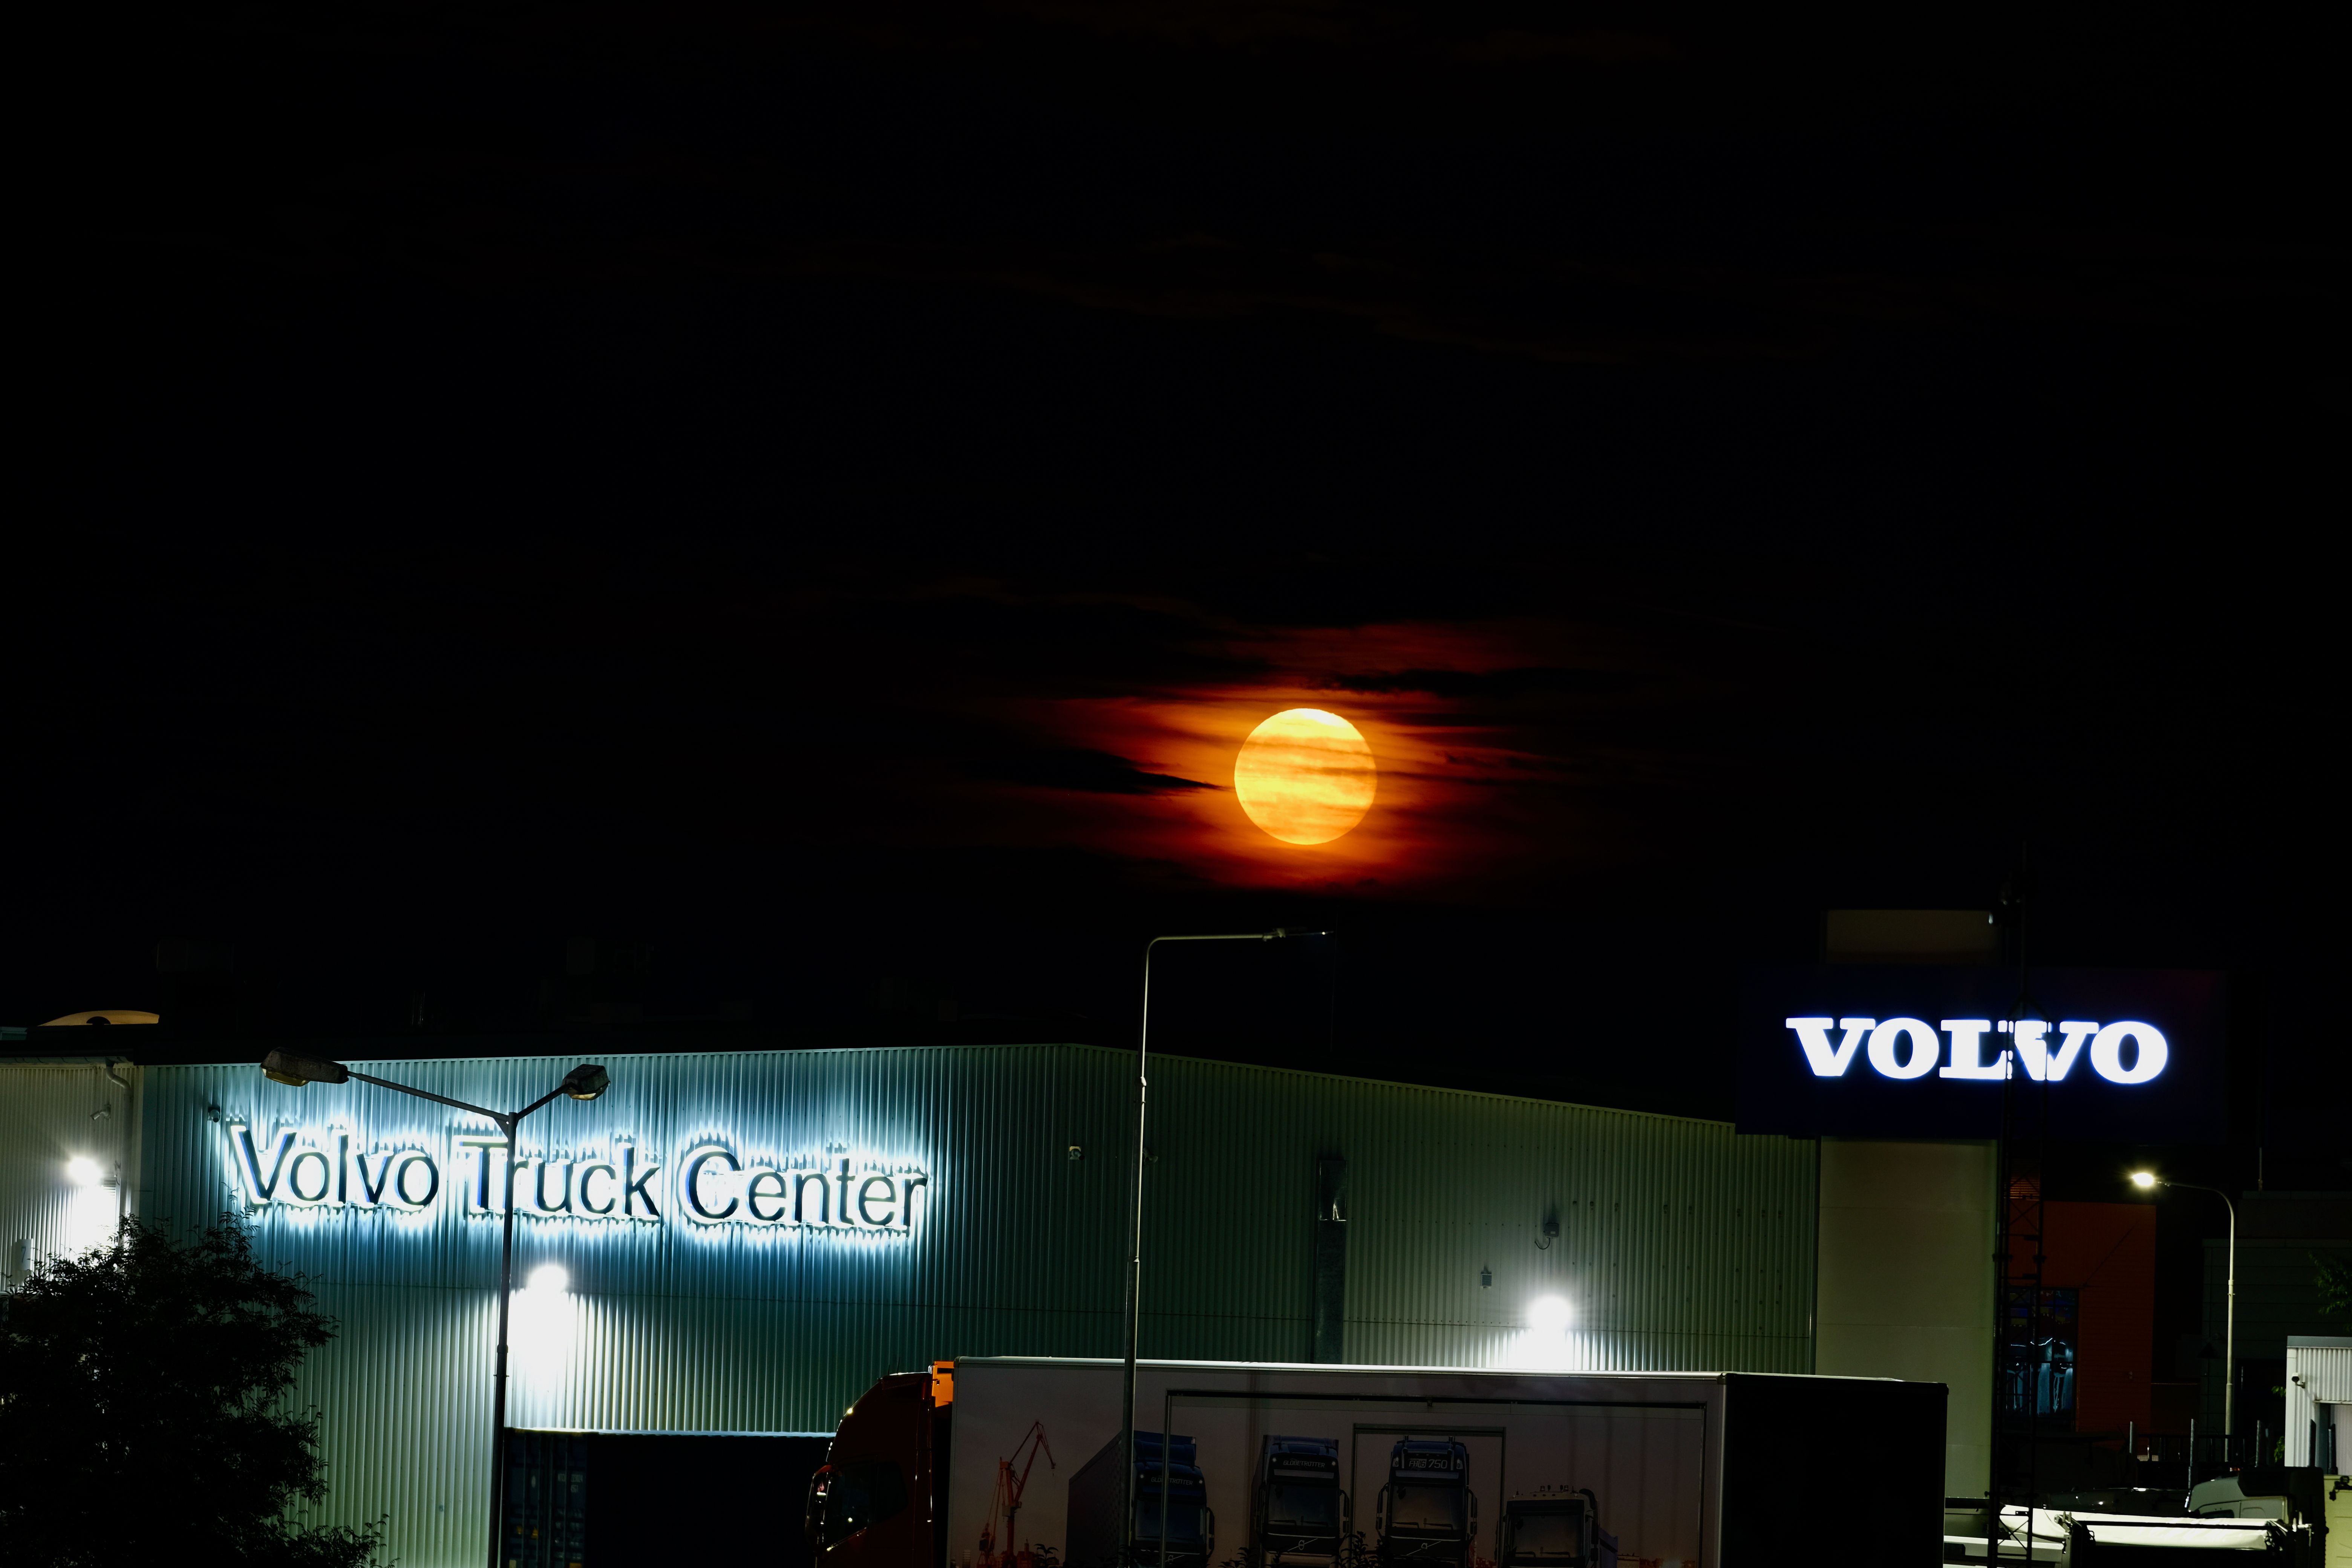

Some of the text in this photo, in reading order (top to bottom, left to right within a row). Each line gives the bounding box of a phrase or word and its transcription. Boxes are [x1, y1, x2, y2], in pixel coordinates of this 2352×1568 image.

[1786, 1018, 2168, 1084] VOLVO
[235, 1129, 439, 1206] Volvo
[684, 1151, 928, 1227] Center
[1283, 1460, 1326, 1468] GLOBETROTTER
[1428, 1459, 1448, 1469] 750
[1151, 1477, 1193, 1486] GLOTROTTER
